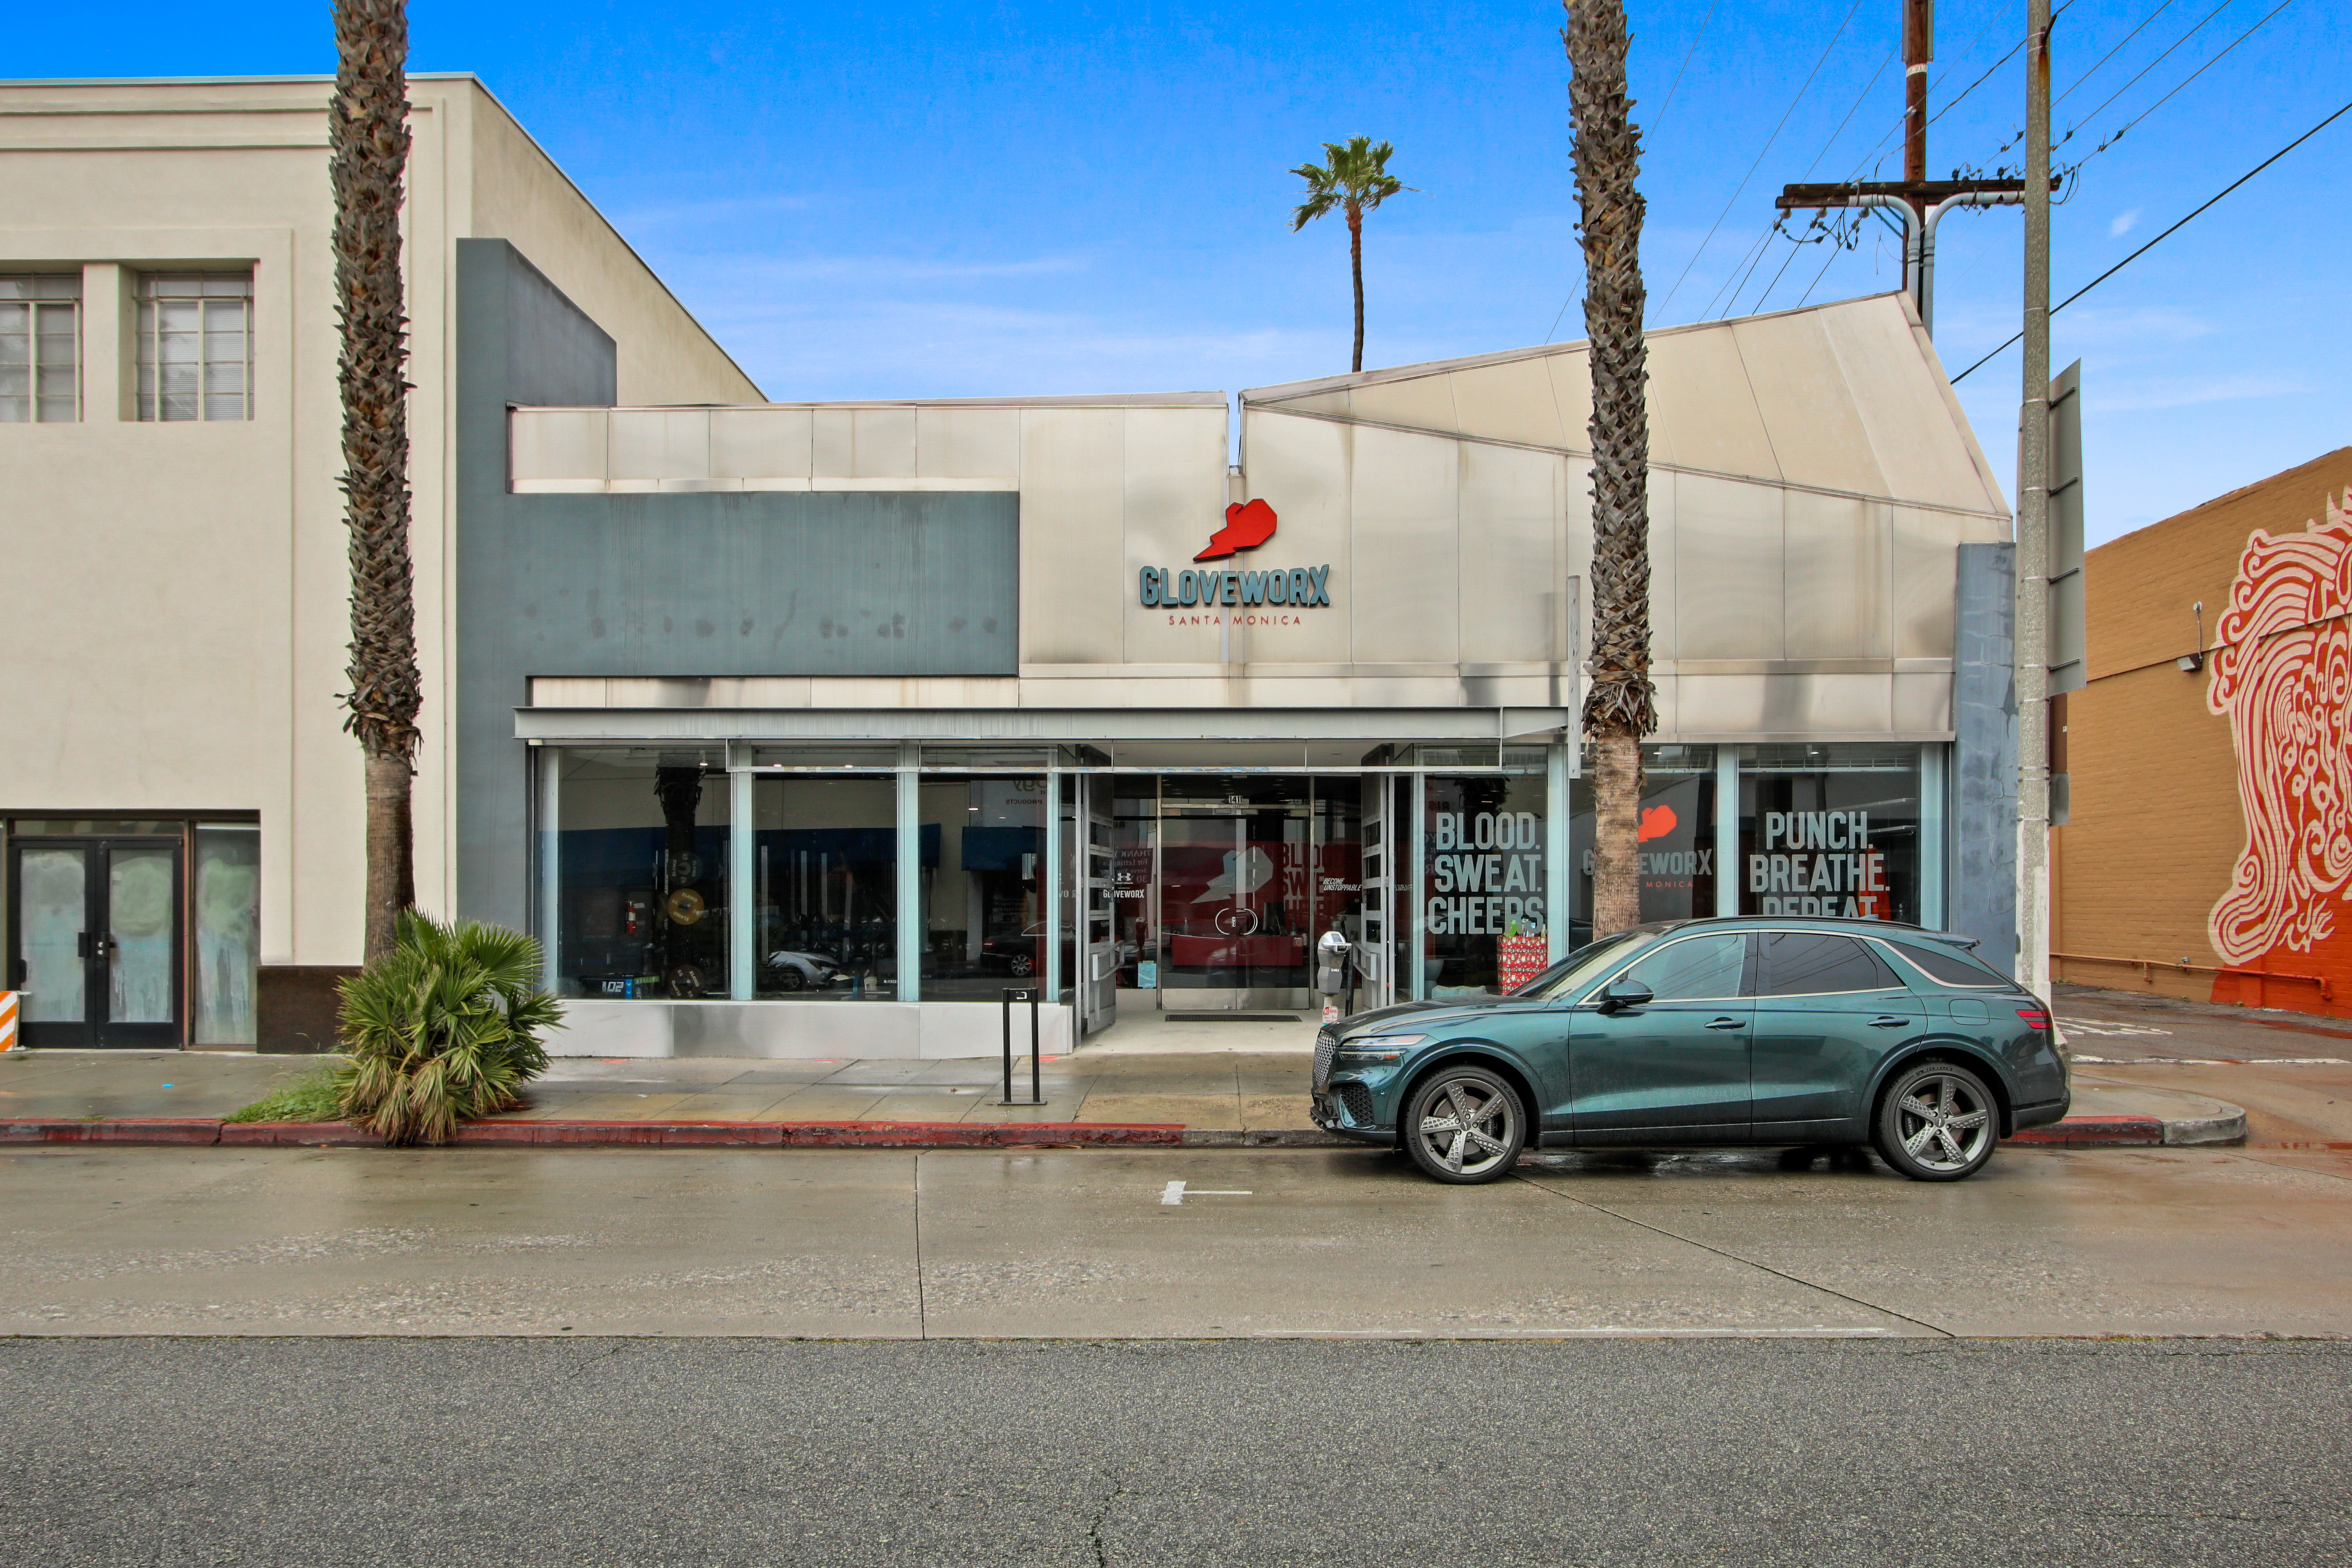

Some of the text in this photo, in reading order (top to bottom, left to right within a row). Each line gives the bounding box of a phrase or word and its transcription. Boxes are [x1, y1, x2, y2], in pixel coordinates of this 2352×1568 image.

[1139, 564, 1330, 608] GLOVEWORX
[1169, 616, 1301, 625] SANTA MONICA
[1436, 812, 1540, 850] BLOOD.
[1766, 811, 1873, 850] PUNCH.
[1435, 854, 1542, 892] SWEAT.
[1583, 849, 1713, 875] GEWORX
[1749, 853, 1890, 892] BREATHE.
